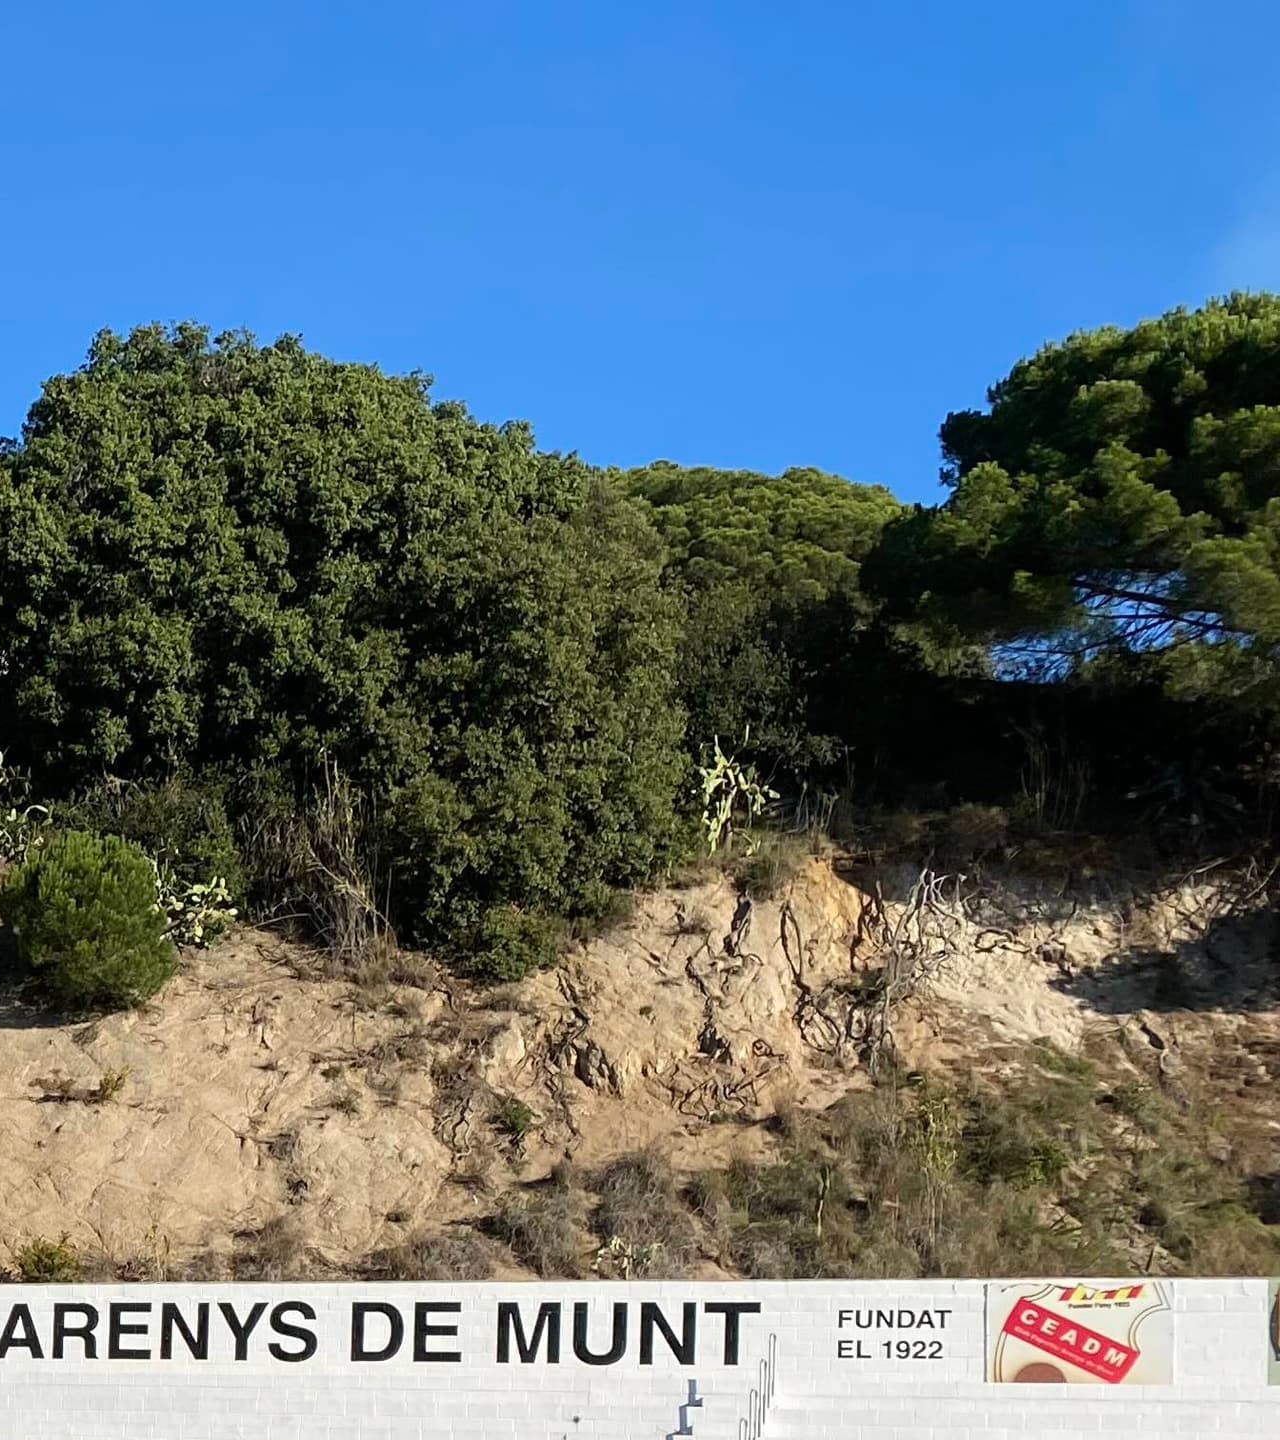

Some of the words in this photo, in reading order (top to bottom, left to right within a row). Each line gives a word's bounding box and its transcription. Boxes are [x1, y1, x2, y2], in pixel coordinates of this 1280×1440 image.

[350, 1301, 462, 1363] DE
[496, 1302, 761, 1366] MUNT
[837, 1308, 953, 1330] FUNDAT
[1019, 1308, 1129, 1368] CEADM
[837, 1339, 872, 1360] EL
[882, 1340, 944, 1360] 1922
